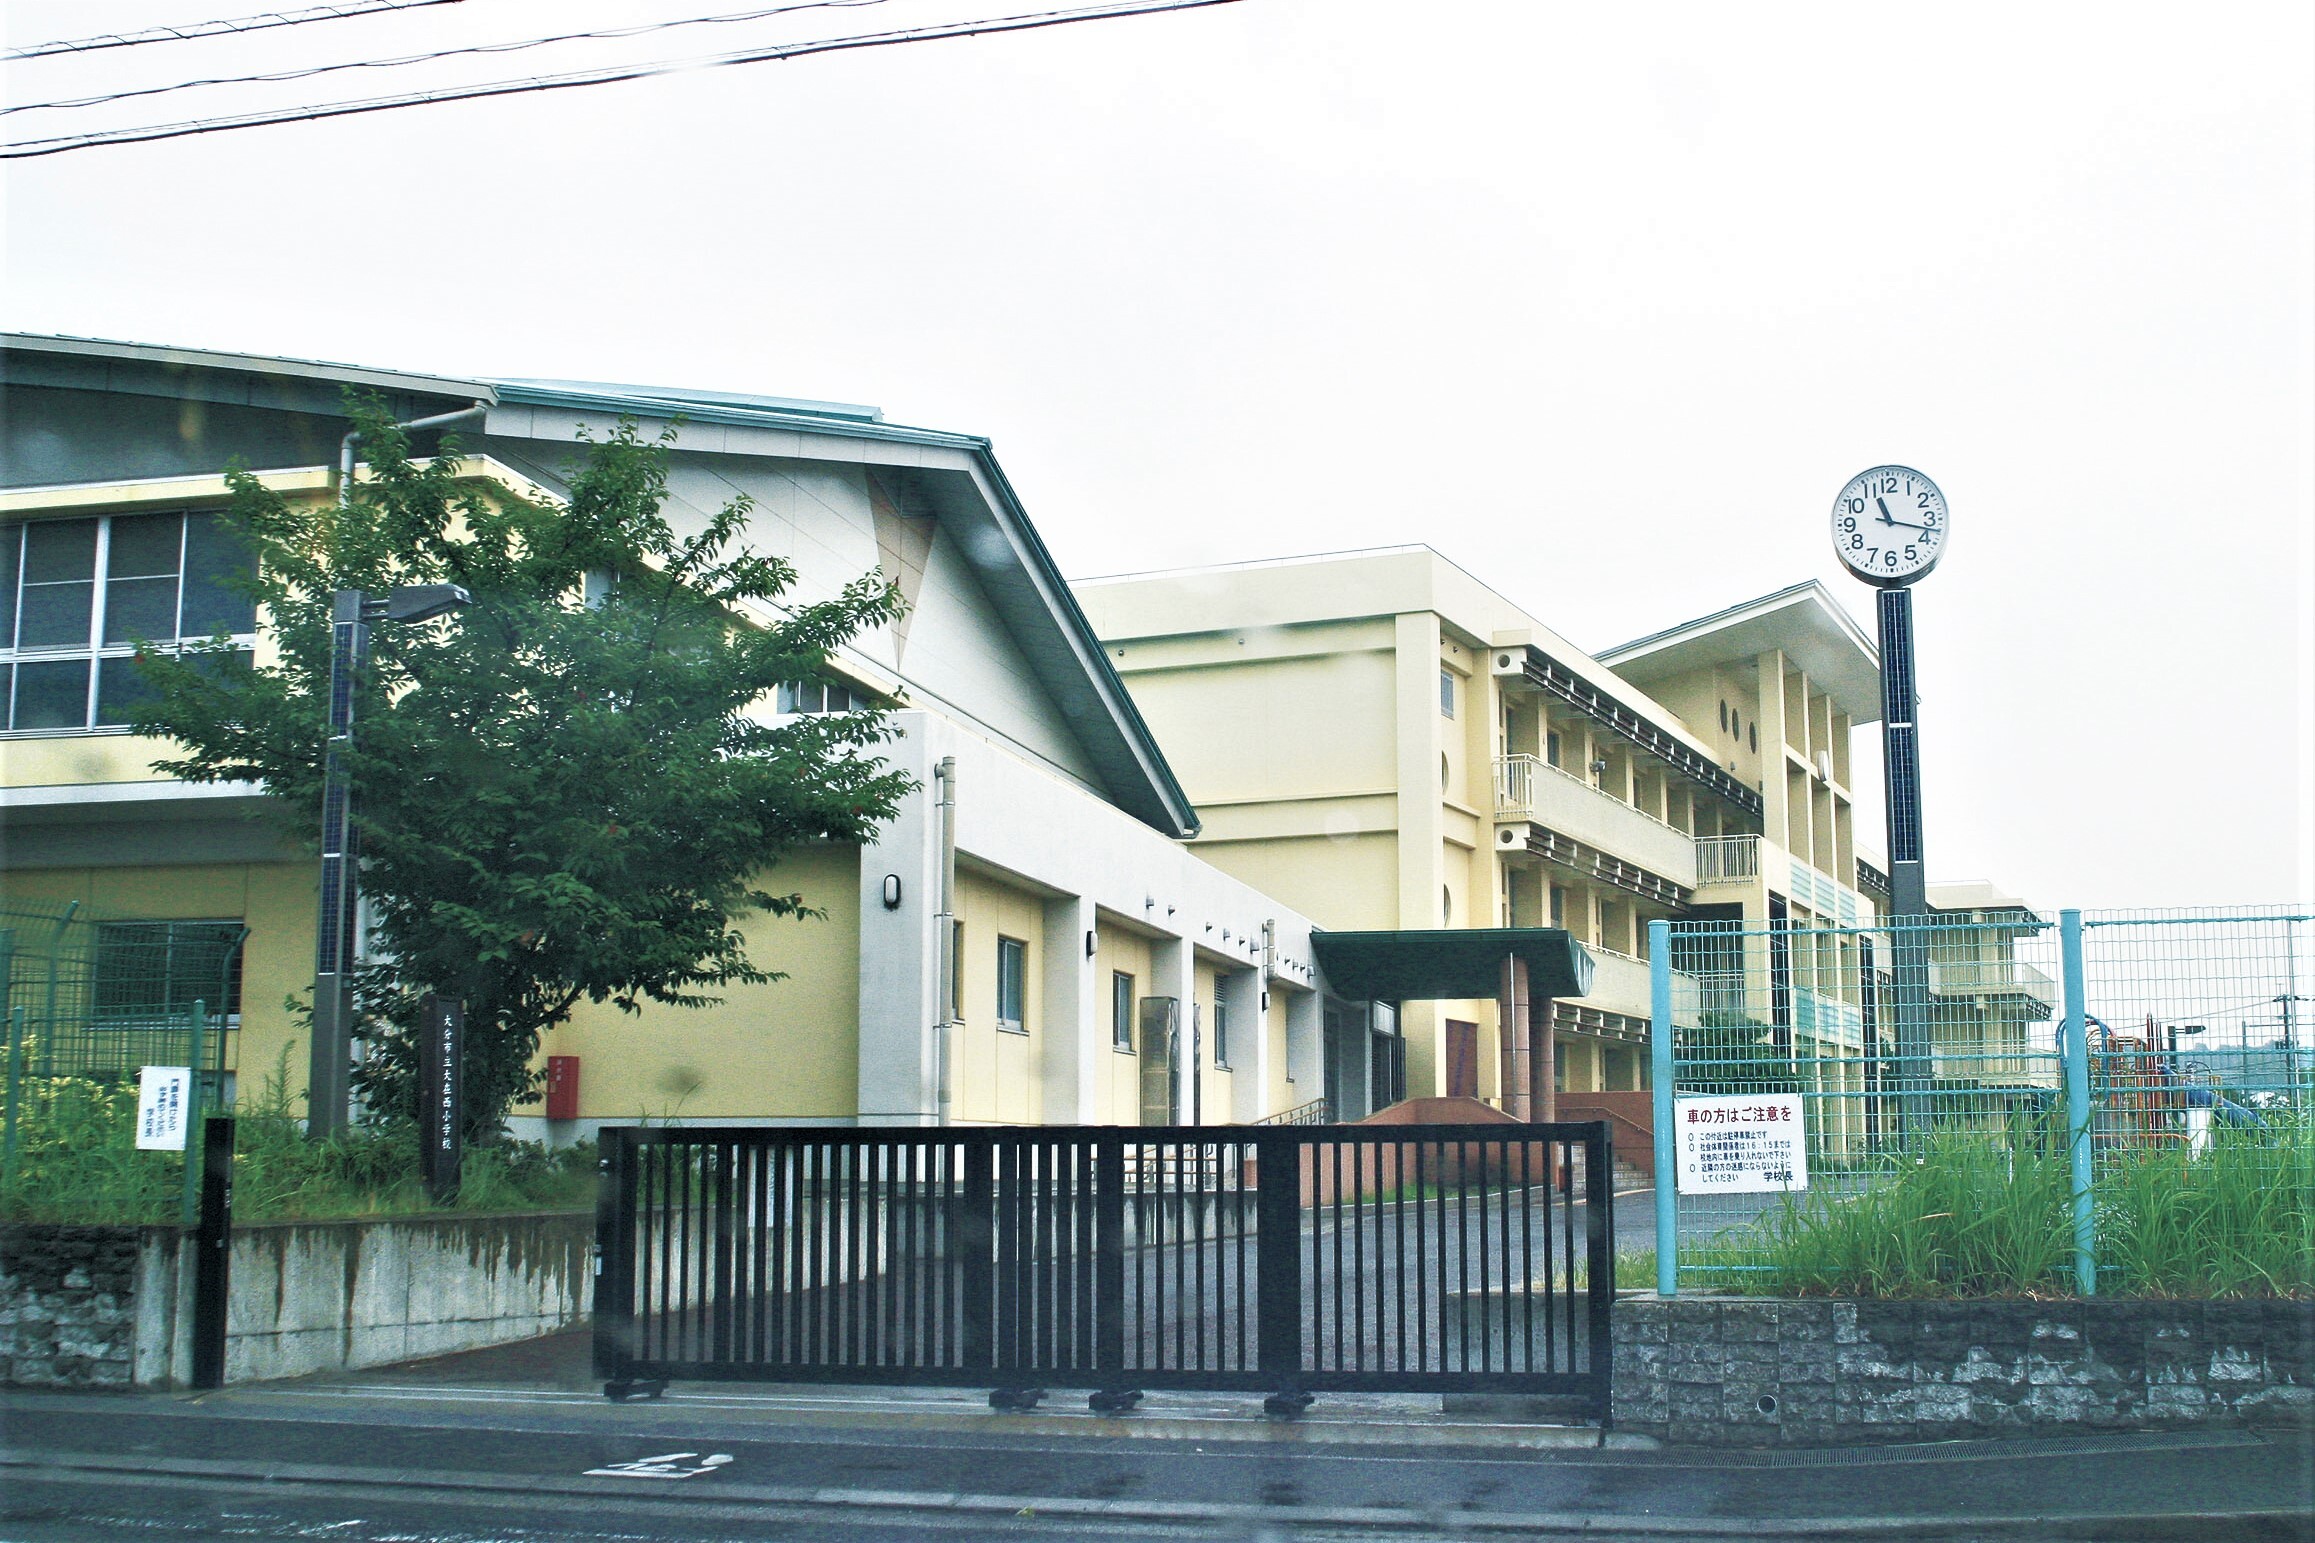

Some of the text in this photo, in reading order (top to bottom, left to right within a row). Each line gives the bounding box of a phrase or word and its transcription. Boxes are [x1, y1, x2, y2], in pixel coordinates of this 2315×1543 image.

[1864, 482, 1877, 499] 11
[1880, 477, 1898, 494] 12
[1906, 480, 1911, 496] 1
[1847, 497, 1865, 515] 10
[1917, 492, 1930, 509] 2
[1843, 517, 1856, 533] 9
[1923, 511, 1936, 527] 3
[1851, 533, 1864, 550] 8
[1917, 529, 1931, 545] 4
[1866, 547, 1879, 563] 7
[1884, 550, 1898, 567] 6
[1904, 544, 1917, 560] 5
[1687, 1105, 1792, 1125] 車の方はご注意を
[1702, 1173, 1740, 1183] してください
[1763, 1171, 1794, 1182] 学校長
